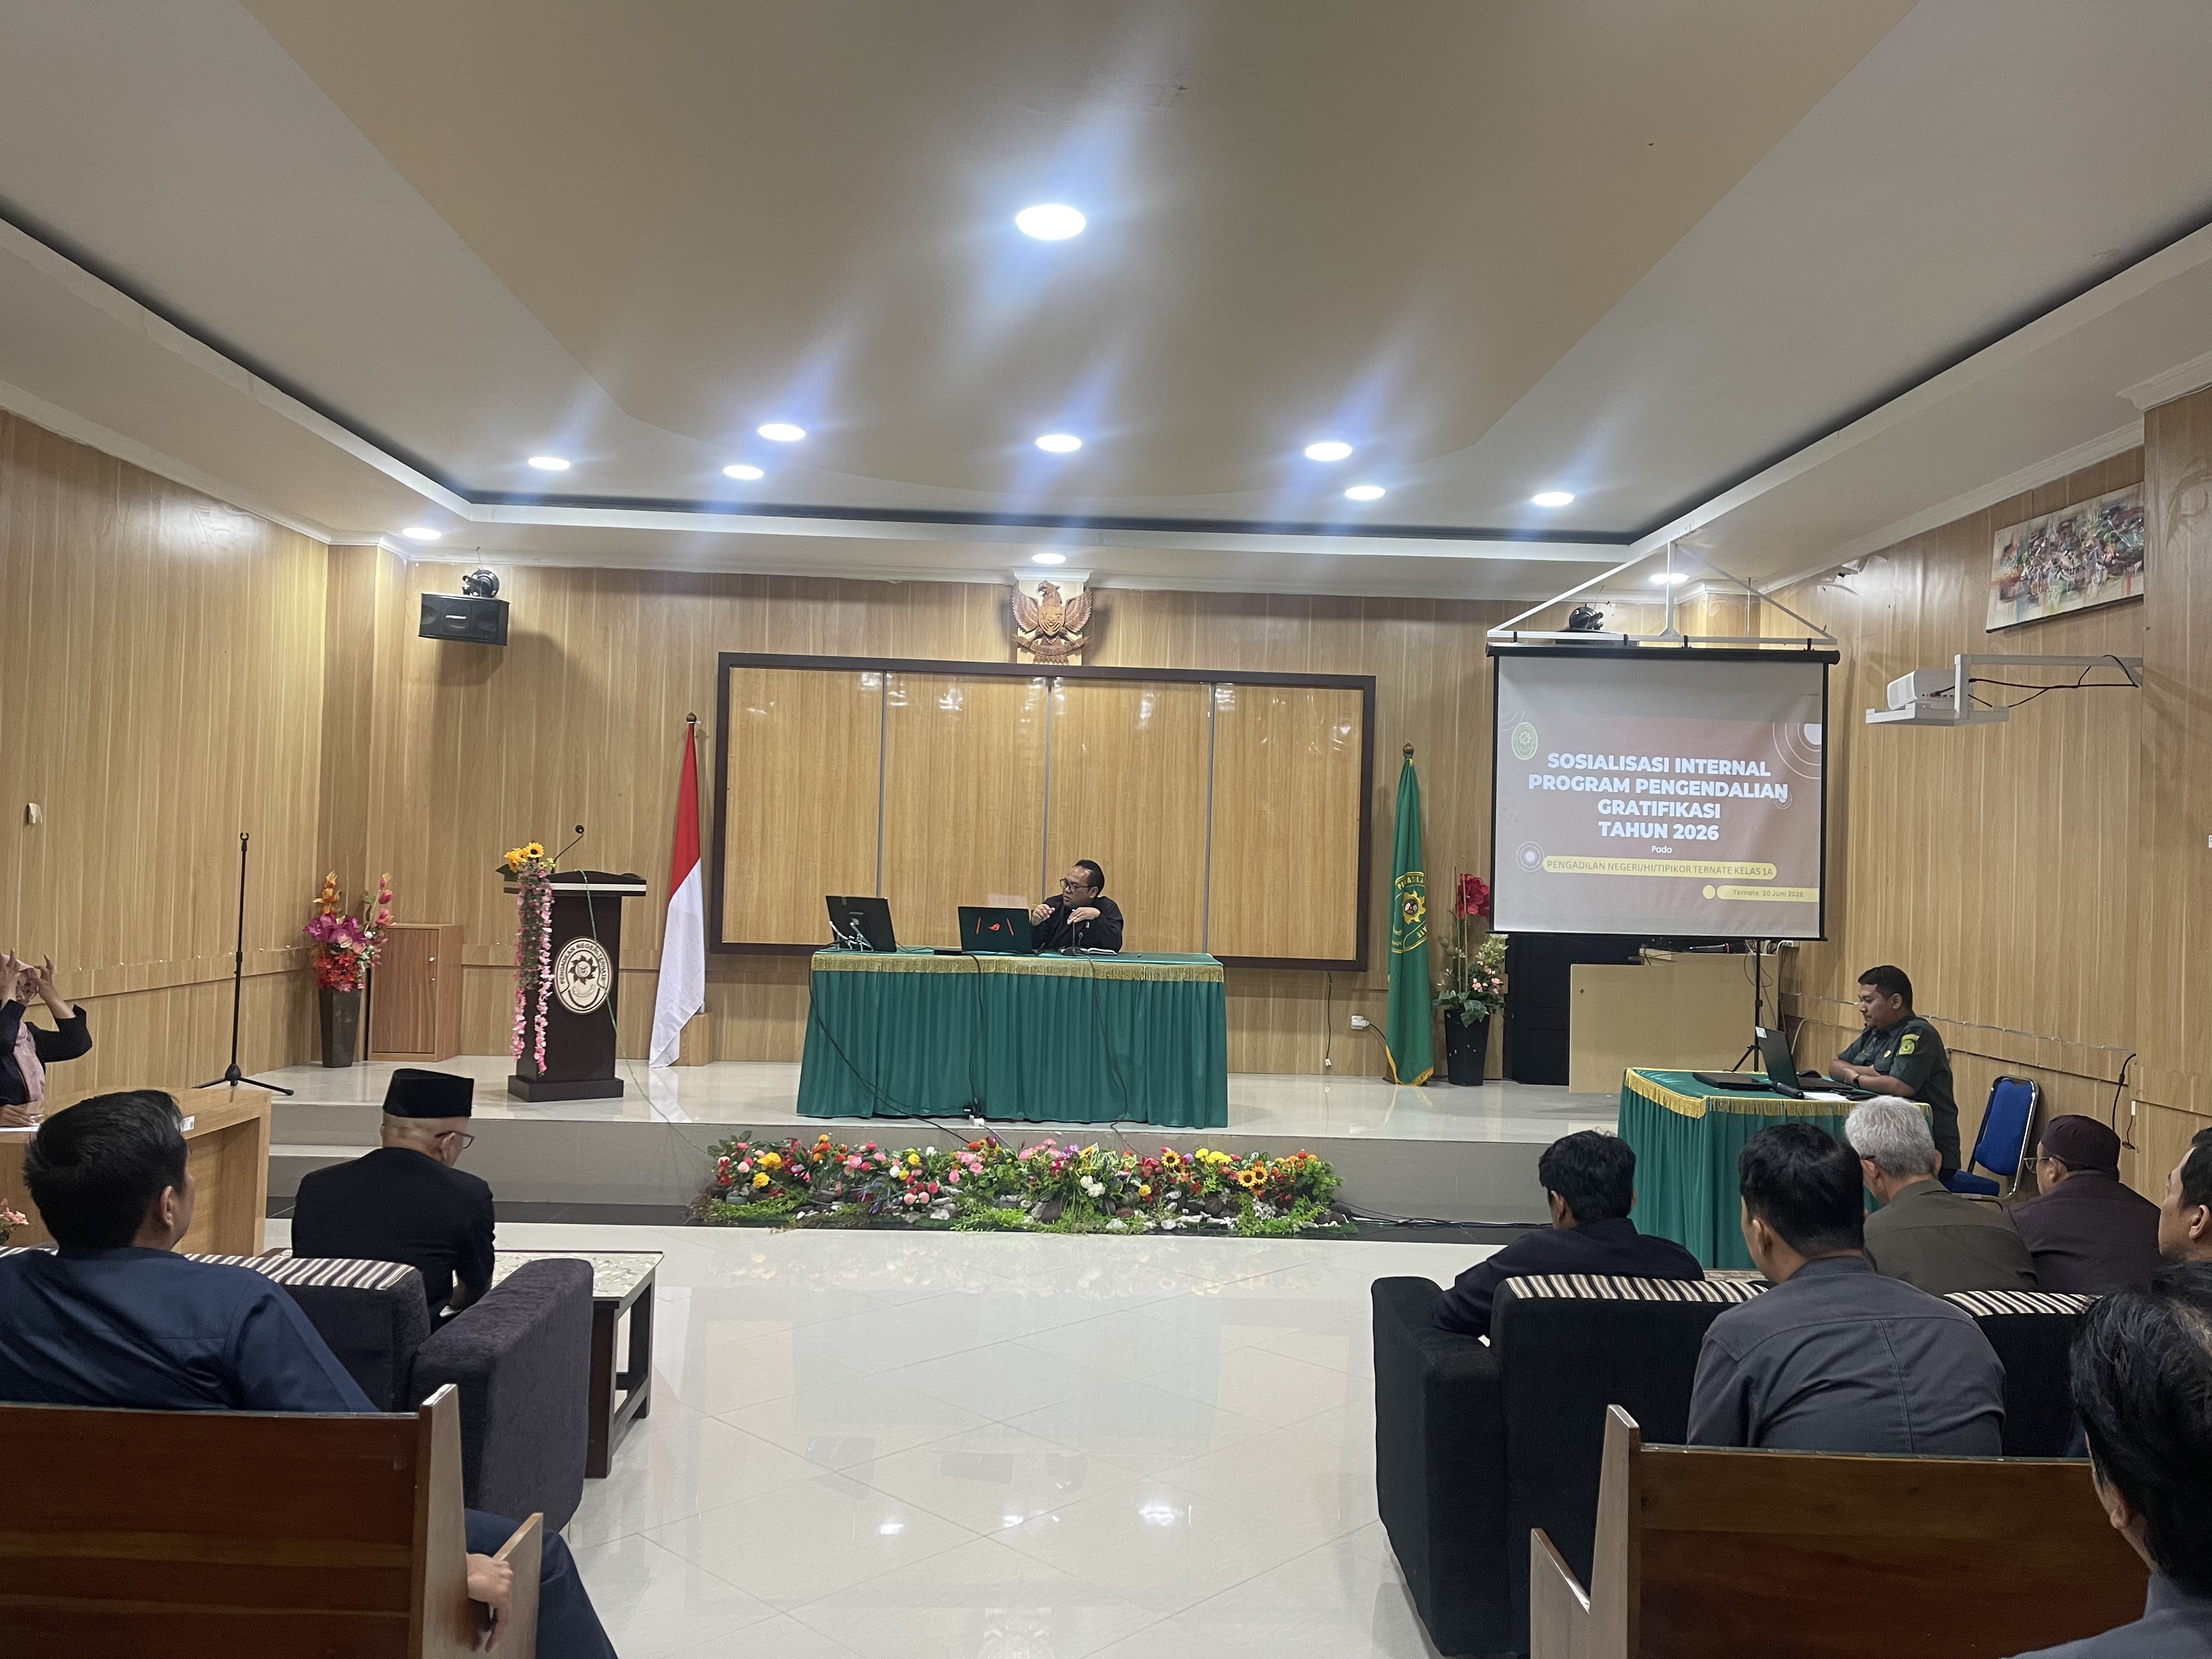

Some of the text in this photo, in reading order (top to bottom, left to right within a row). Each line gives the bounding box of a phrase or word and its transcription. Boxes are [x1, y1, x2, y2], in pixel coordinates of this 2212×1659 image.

[1548, 753, 1771, 776] SOSIALISASI INTERNAL
[1528, 774, 1788, 799] PROGRAM PENGENDALIAN
[1598, 799, 1720, 819] GRATIFIKASI
[1598, 821, 1719, 840] TAHUN 2026
[1651, 845, 1672, 854] Pada
[1547, 861, 1605, 870] PENGADILAN
[1693, 865, 1733, 874] TERNATE
[1734, 867, 1760, 875] KELAS
